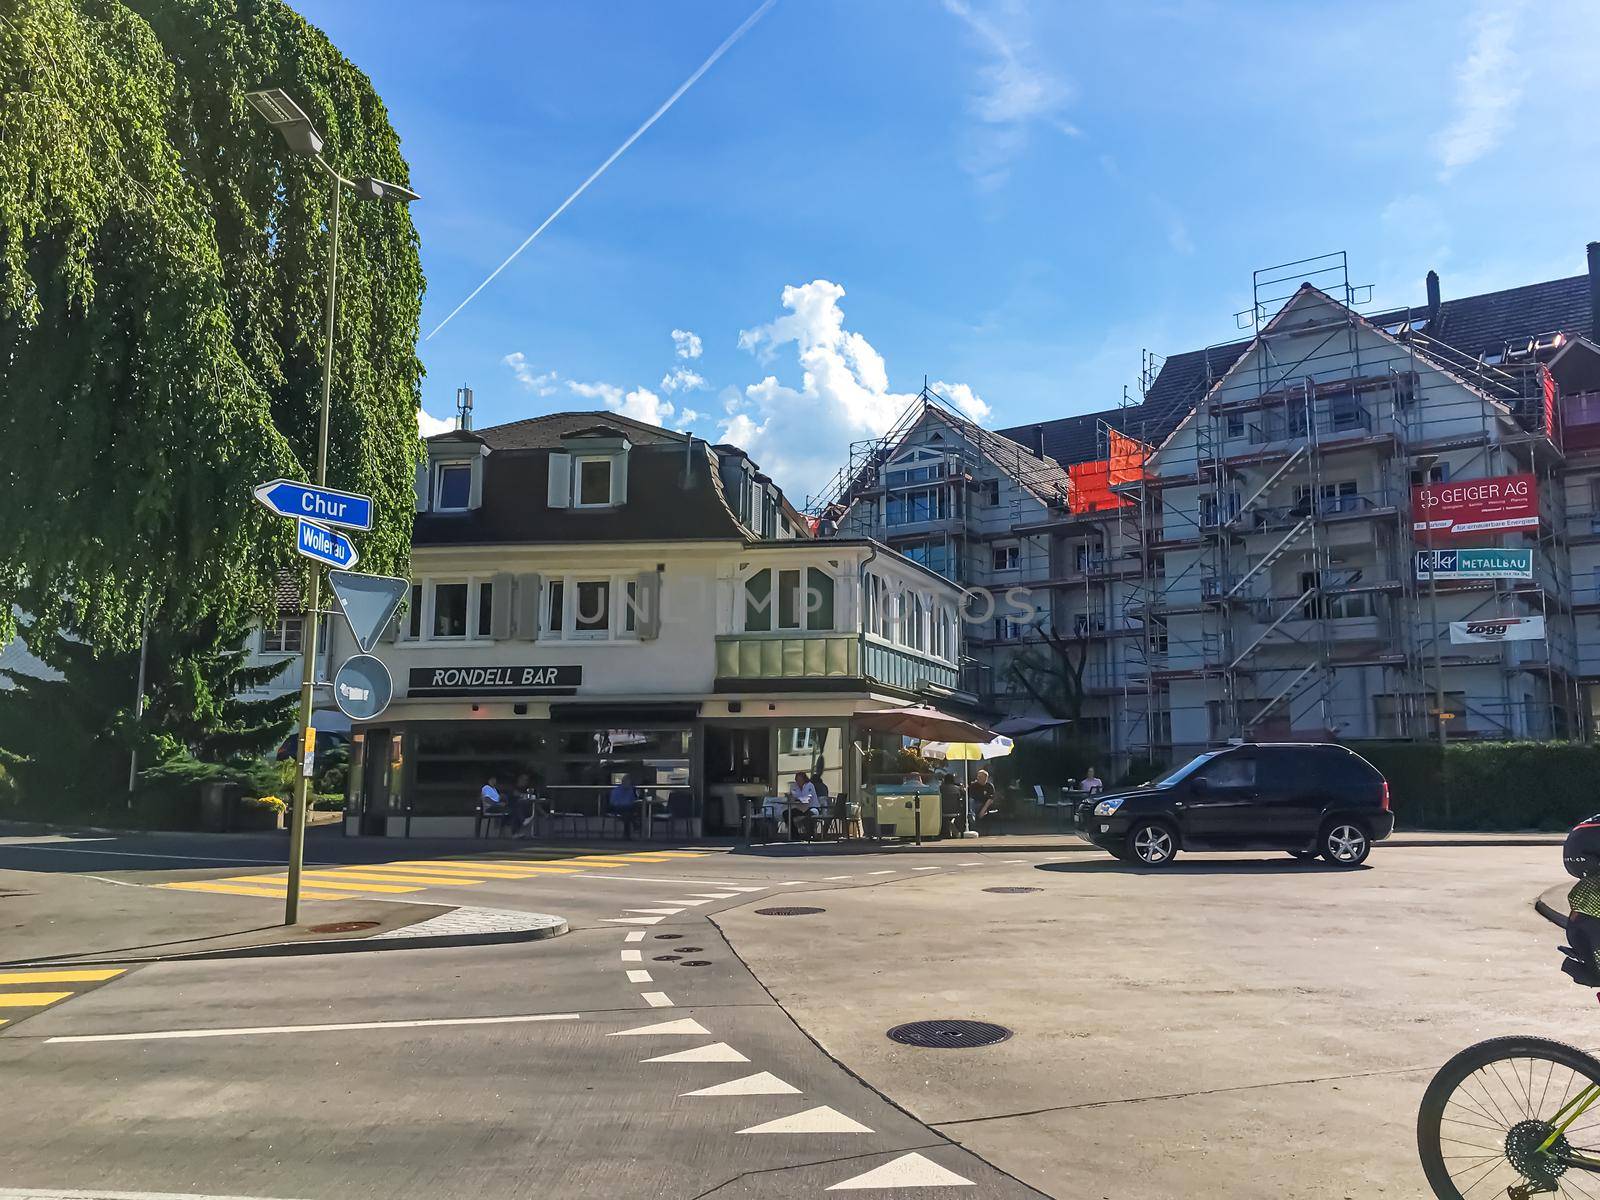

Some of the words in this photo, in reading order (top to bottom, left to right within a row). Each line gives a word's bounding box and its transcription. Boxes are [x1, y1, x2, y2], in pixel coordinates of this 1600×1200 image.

[1441, 484, 1500, 503] GEIGER
[1504, 481, 1528, 497] AG
[301, 492, 347, 517] Chur
[1507, 518, 1536, 527] Energien
[303, 526, 345, 560] Wollerau
[1462, 559, 1526, 569] METALLBAU
[432, 668, 514, 686] RONDELL
[521, 667, 558, 684] BAR
